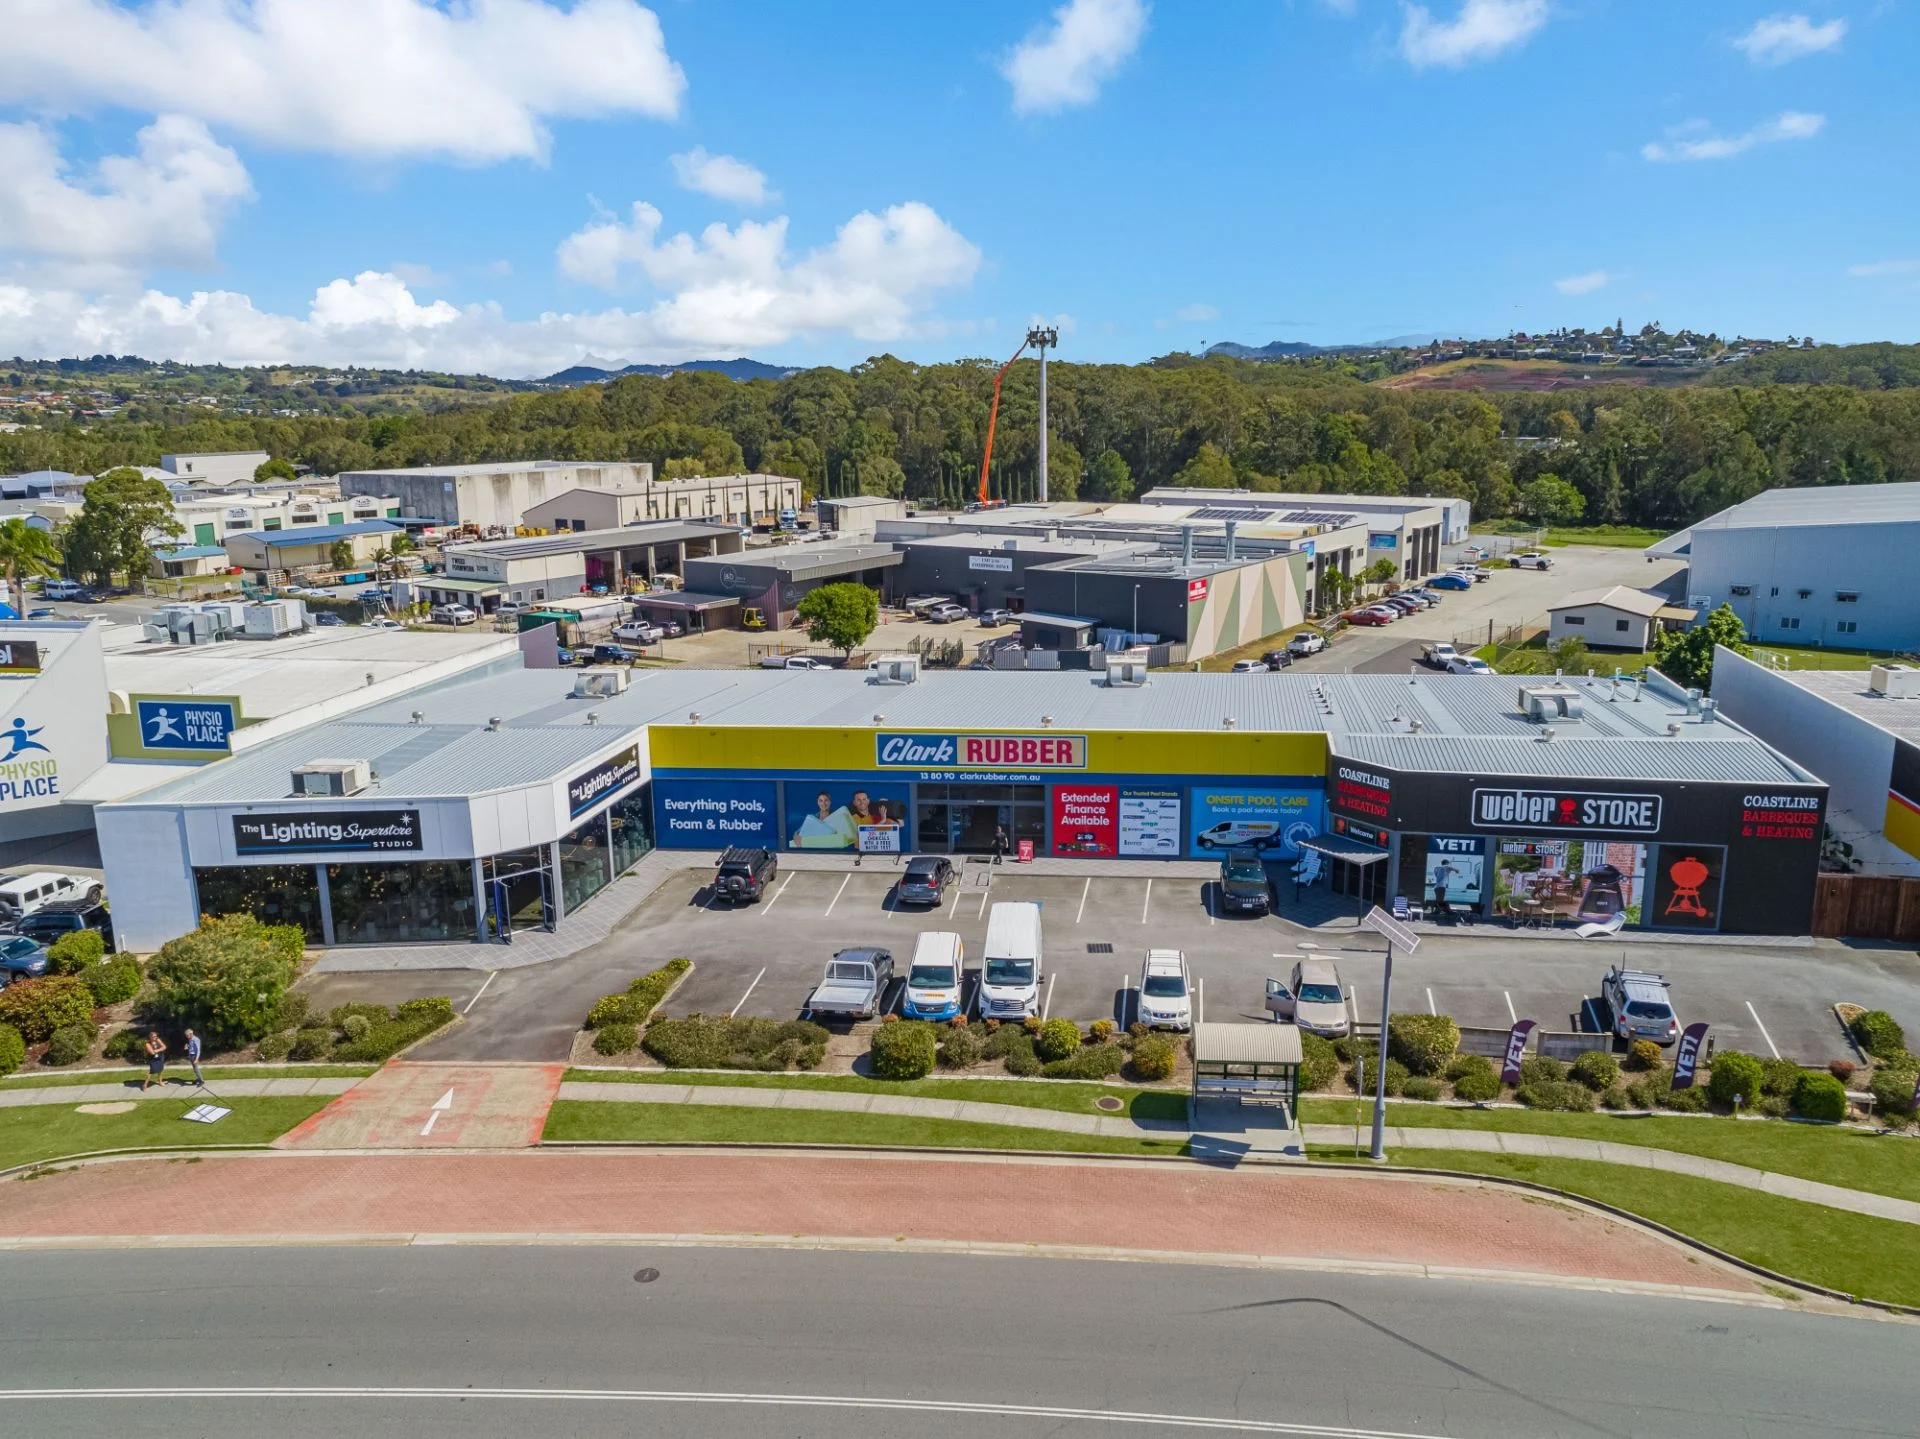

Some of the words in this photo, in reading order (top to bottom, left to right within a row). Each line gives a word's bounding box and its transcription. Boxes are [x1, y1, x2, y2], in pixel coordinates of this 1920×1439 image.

[184, 711, 222, 726] PHYSIO
[186, 726, 225, 743] PLACE
[881, 737, 954, 762] Clark
[967, 739, 1073, 764] RUBBER
[920, 772, 929, 780] 13
[930, 772, 943, 780] 80
[959, 773, 1041, 782] clarkrubber.com.au
[1339, 767, 1390, 789] COASTLINE
[0, 776, 60, 801] PLACE
[579, 772, 613, 801] Lighting
[1061, 792, 1110, 803] Extended
[1206, 795, 1244, 805] ONSITE
[1248, 796, 1277, 806] POOL
[1280, 796, 1309, 806] CARE
[1743, 795, 1818, 809] COASTLINE
[664, 799, 727, 813] Everything
[730, 800, 766, 813] Pools,
[1065, 804, 1106, 814] Finance
[1237, 806, 1253, 815] pool
[1347, 797, 1387, 817] HEATING
[1481, 791, 1556, 823] weber
[1582, 799, 1653, 826] STORE
[1061, 815, 1110, 826] Available
[1743, 810, 1818, 824] BARBEQUES
[670, 818, 703, 830] Foam
[706, 819, 716, 830] &
[719, 819, 763, 831] Rubber
[241, 824, 259, 833] The
[260, 822, 343, 843] Lighting
[343, 823, 413, 840] Superstore
[1742, 827, 1752, 837] &
[1756, 827, 1814, 839] HEATING
[373, 840, 413, 848] STUDIO
[1436, 838, 1476, 851] YETI
[1535, 843, 1560, 855] STORE
[1504, 1030, 1527, 1074] YETI
[1675, 1035, 1699, 1079] YETI
